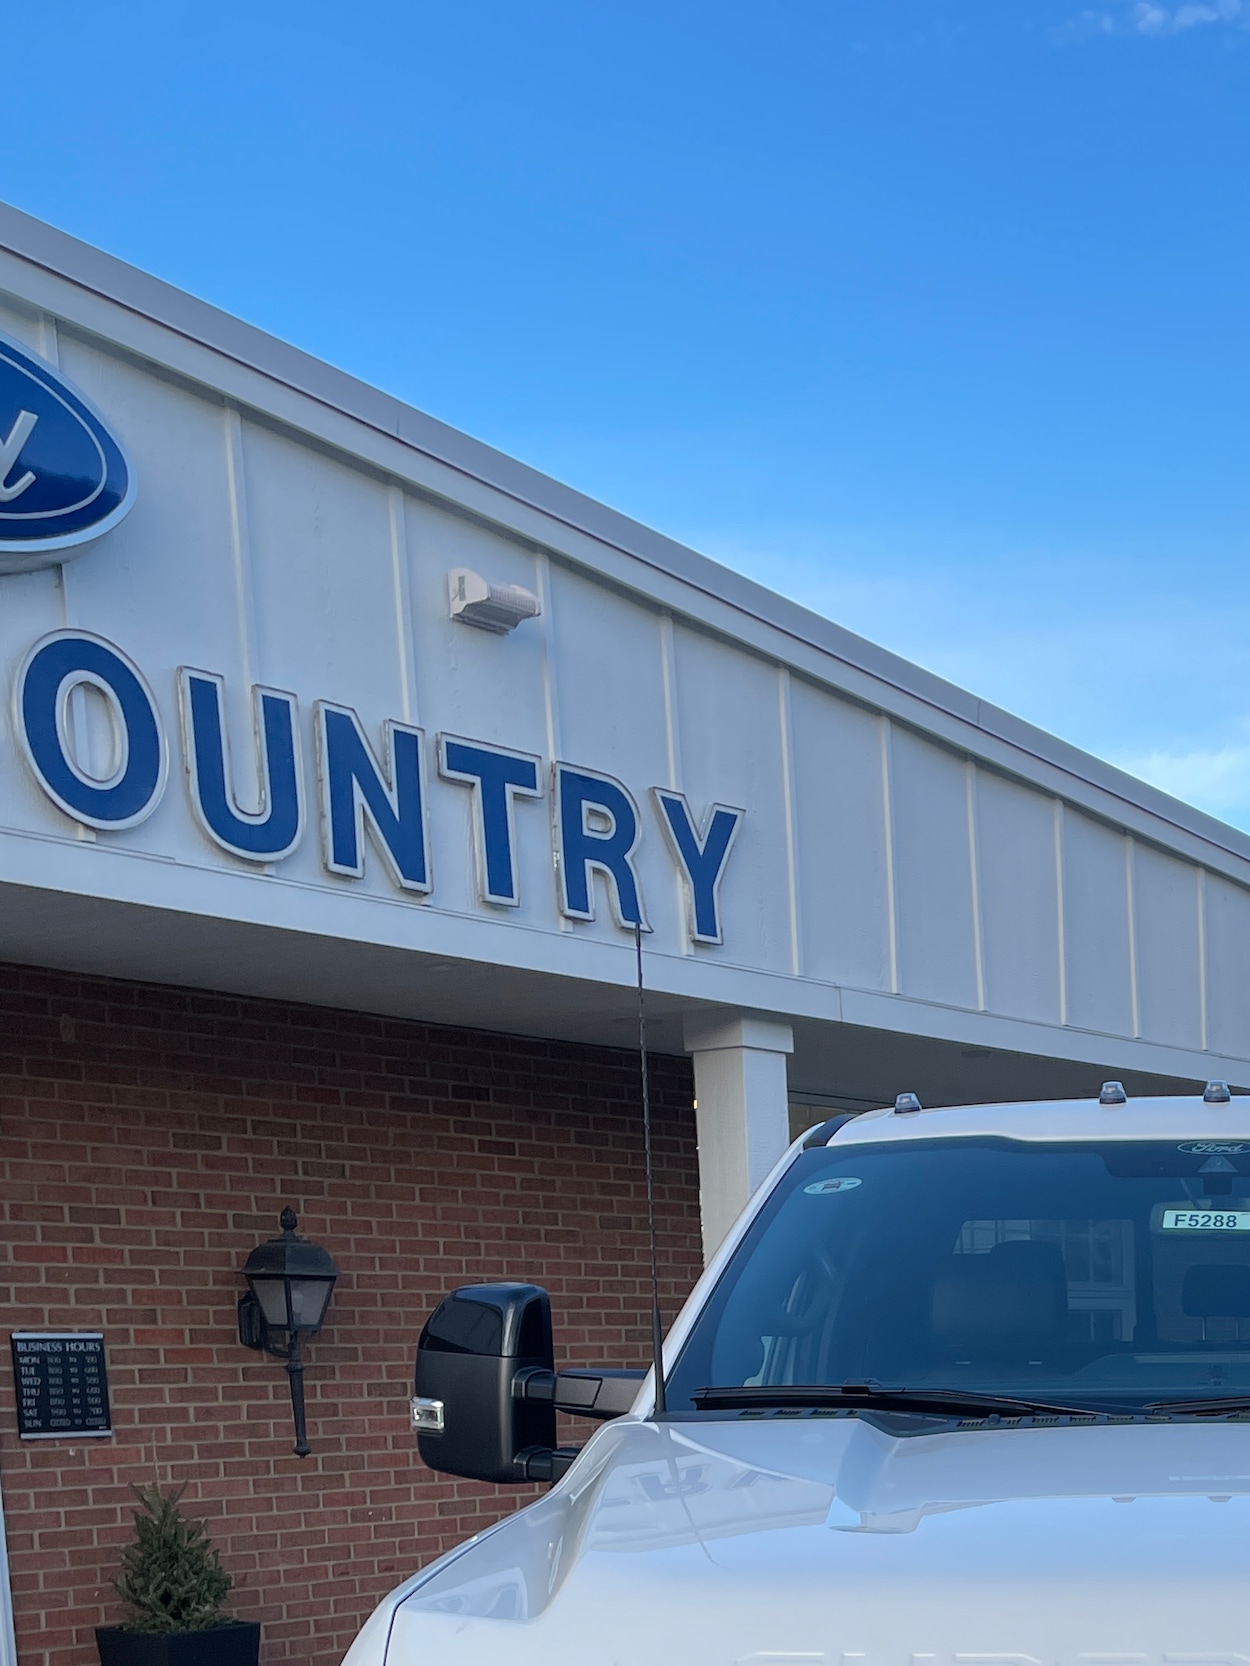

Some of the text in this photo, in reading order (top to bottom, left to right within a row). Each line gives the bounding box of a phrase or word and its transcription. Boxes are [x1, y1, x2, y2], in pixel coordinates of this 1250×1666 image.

[12, 628, 746, 945] OUNTRY
[1191, 1143, 1244, 1153] Ford
[1173, 1213, 1238, 1228] F5288
[17, 1341, 101, 1353] BUSINESS HOURS
